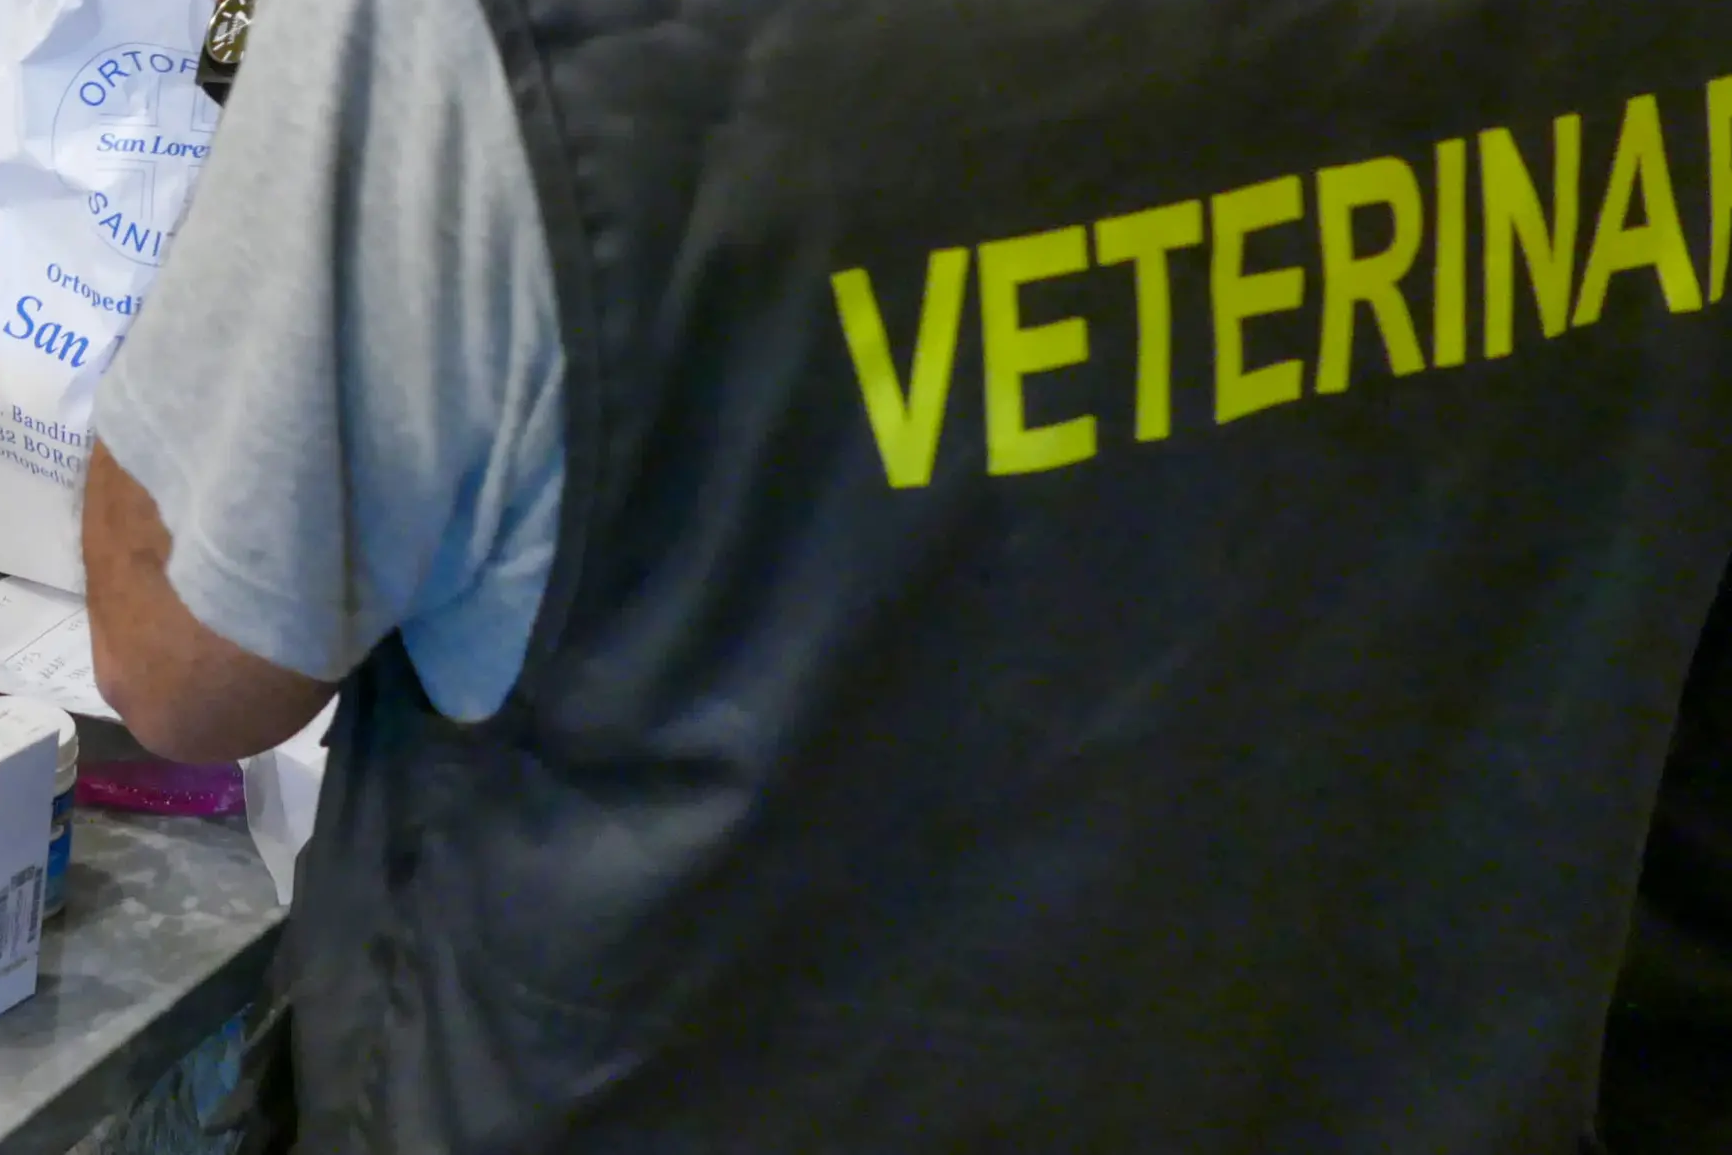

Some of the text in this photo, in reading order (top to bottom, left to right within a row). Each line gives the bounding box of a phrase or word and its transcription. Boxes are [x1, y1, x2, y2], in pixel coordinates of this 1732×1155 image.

[97, 132, 211, 159] San Lore
[46, 262, 142, 316] Ortopedi
[3, 295, 90, 368] San
